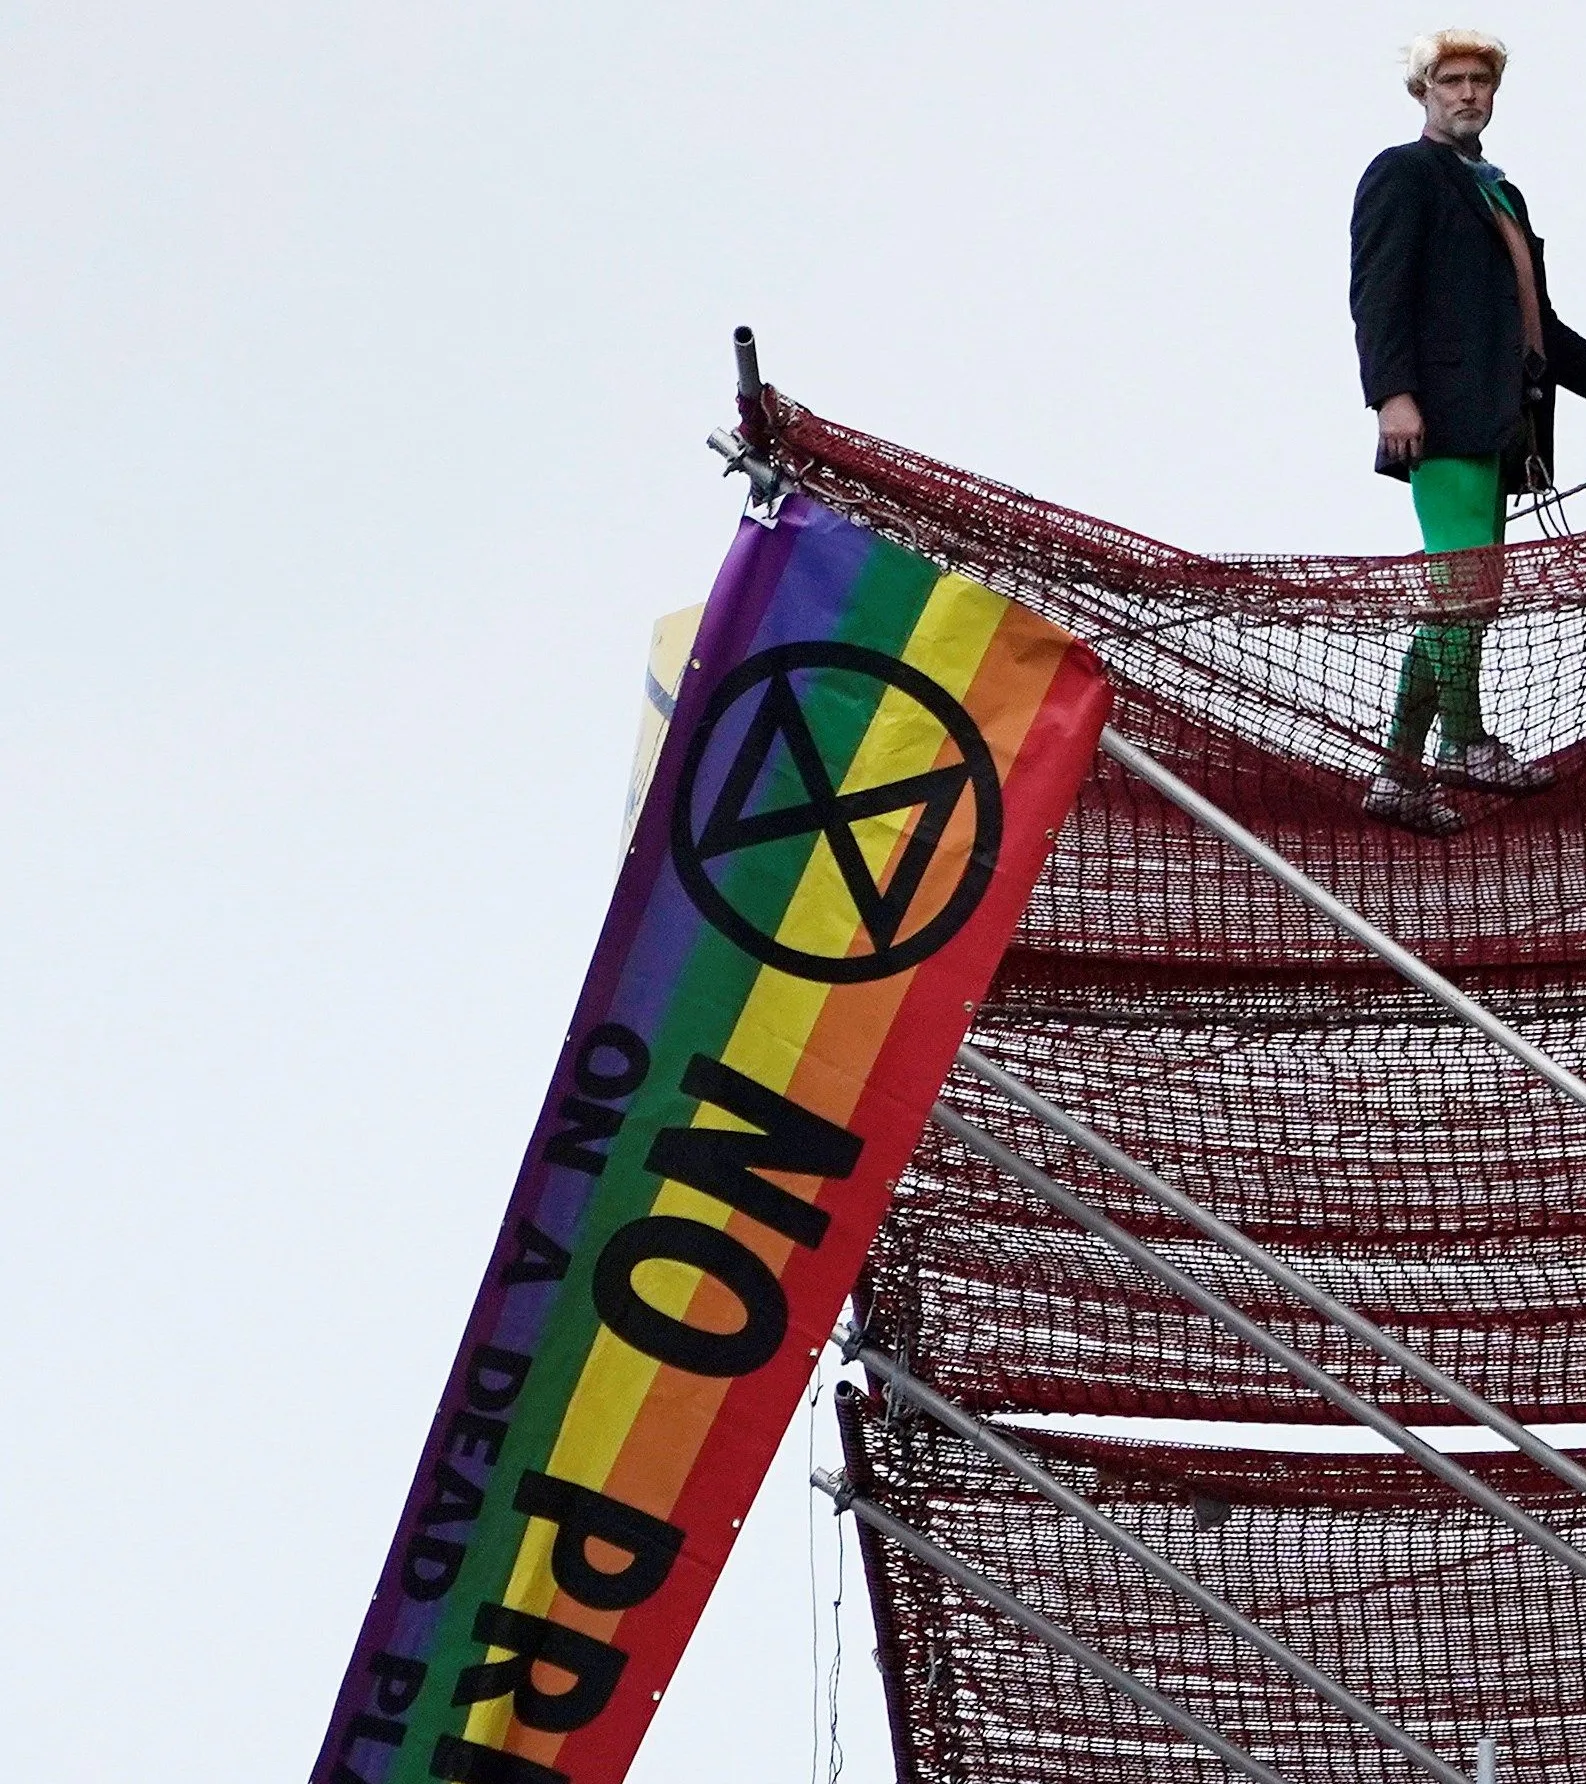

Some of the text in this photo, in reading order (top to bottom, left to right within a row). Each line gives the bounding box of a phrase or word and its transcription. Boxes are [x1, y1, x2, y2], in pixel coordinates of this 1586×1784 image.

[333, 1022, 650, 1784] ON A DEAD PL
[593, 1053, 864, 1378] NO
